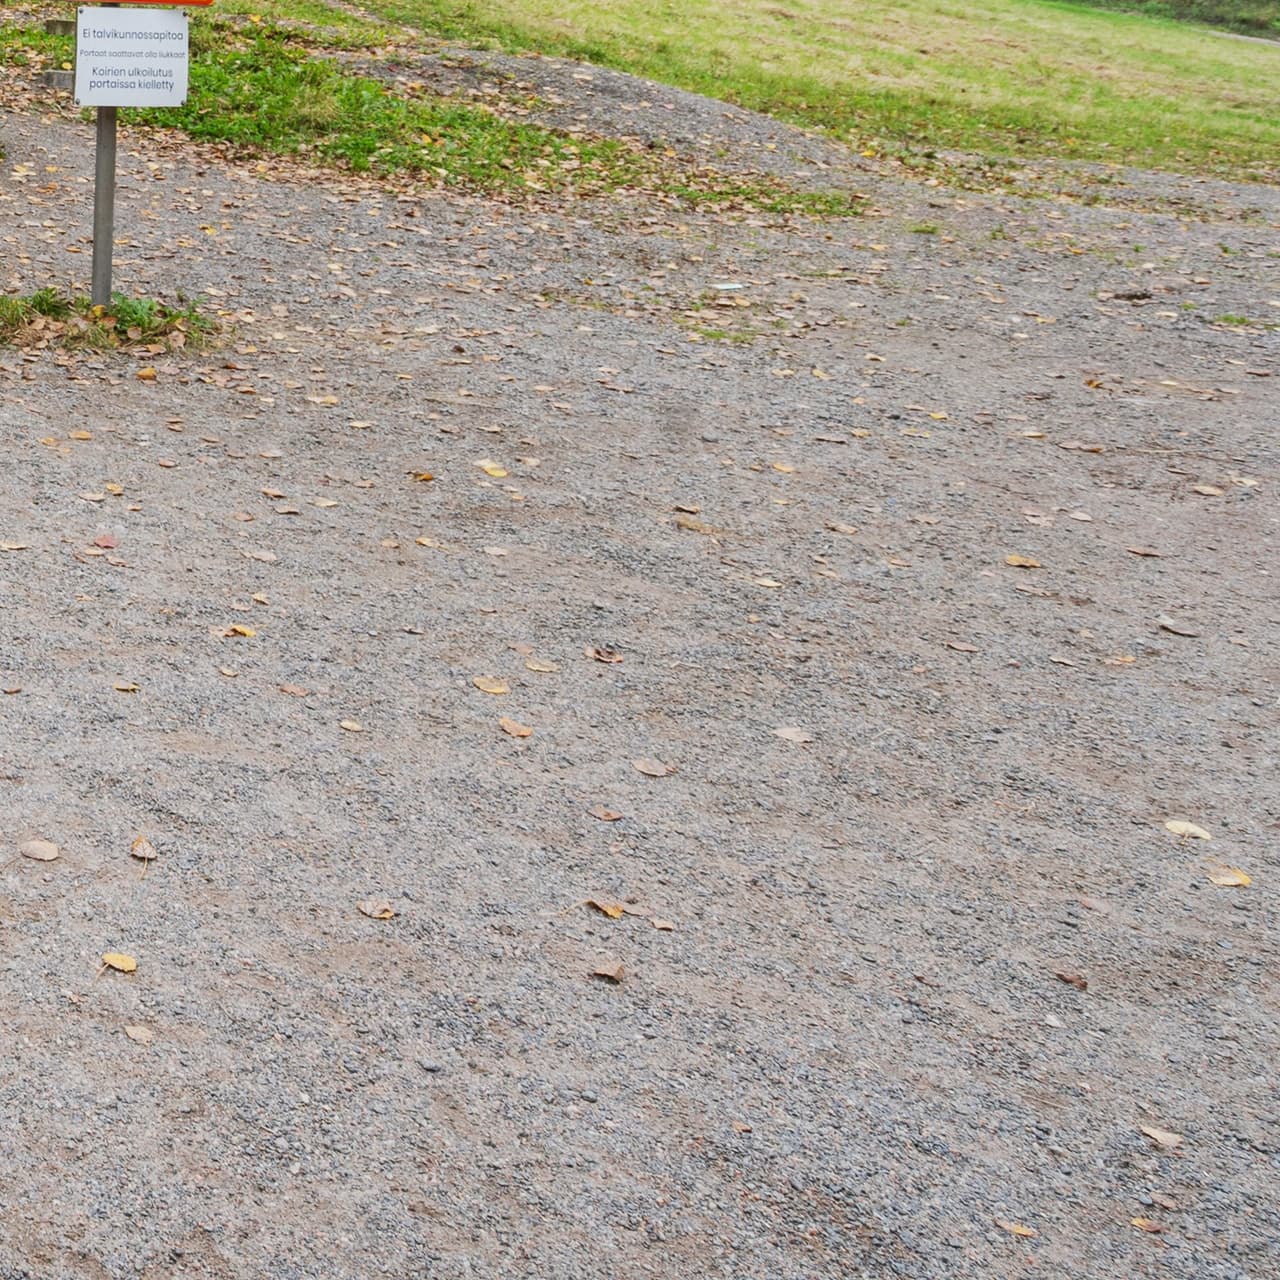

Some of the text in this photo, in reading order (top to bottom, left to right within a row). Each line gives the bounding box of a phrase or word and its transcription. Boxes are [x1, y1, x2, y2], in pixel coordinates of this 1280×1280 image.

[82, 28, 184, 42] Ei talvikunnossapitoa
[92, 66, 174, 78] Koirien ulkoilutus
[89, 79, 175, 92] portaissa kielletty
